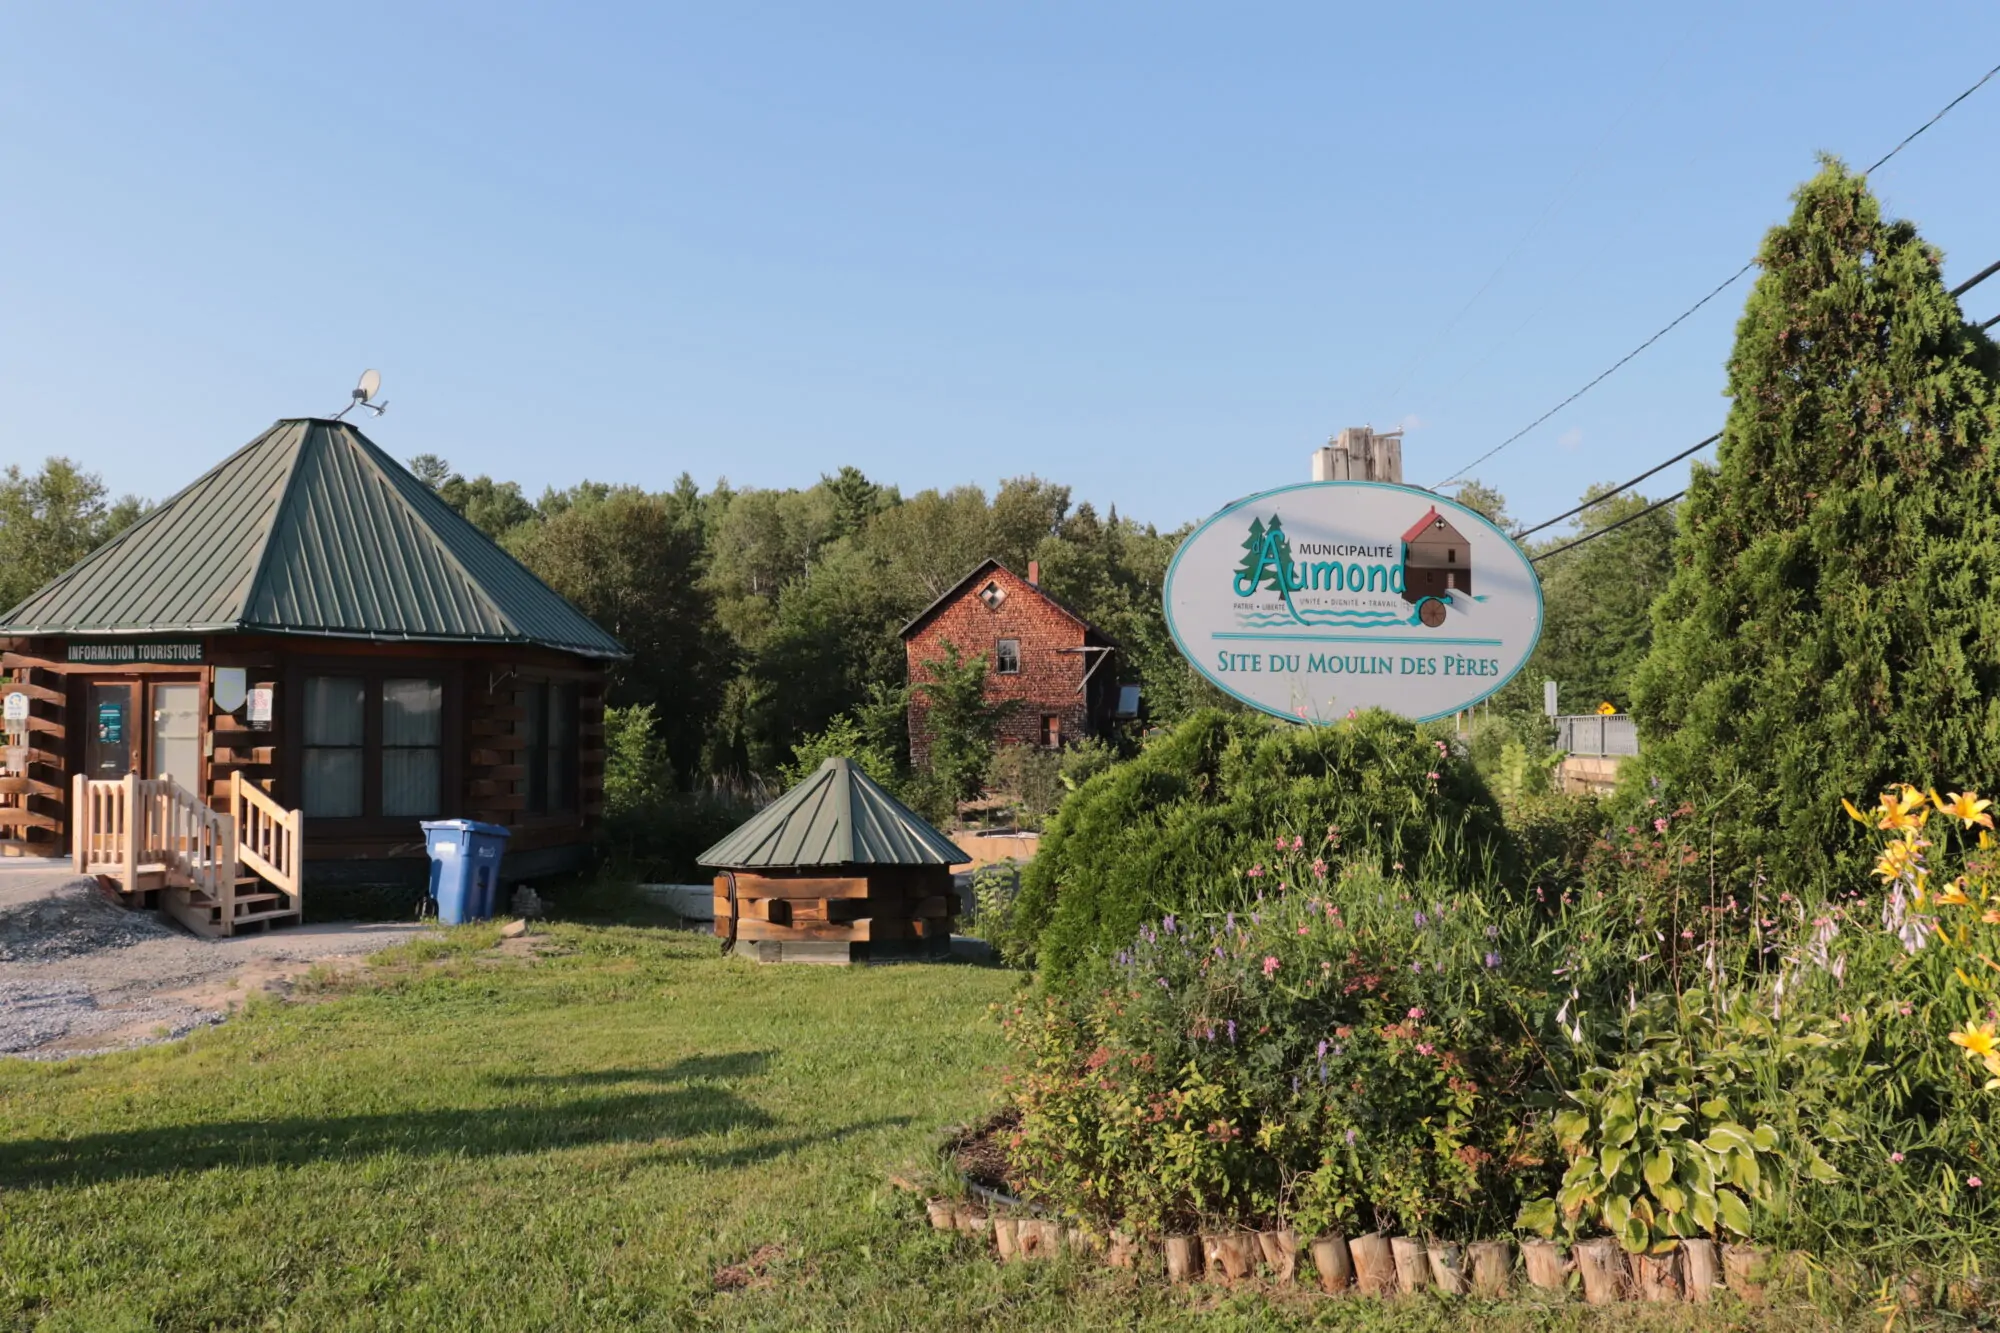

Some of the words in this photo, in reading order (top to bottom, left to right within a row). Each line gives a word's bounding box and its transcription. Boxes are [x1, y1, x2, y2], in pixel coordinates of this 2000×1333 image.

[1299, 543, 1393, 558] MUNICIPALITÉ
[1233, 602, 1253, 611] PATRIE
[1369, 600, 1397, 608] TRAVAIL
[68, 645, 135, 660] INFORMATION
[137, 644, 202, 660] TOURISTIQUE
